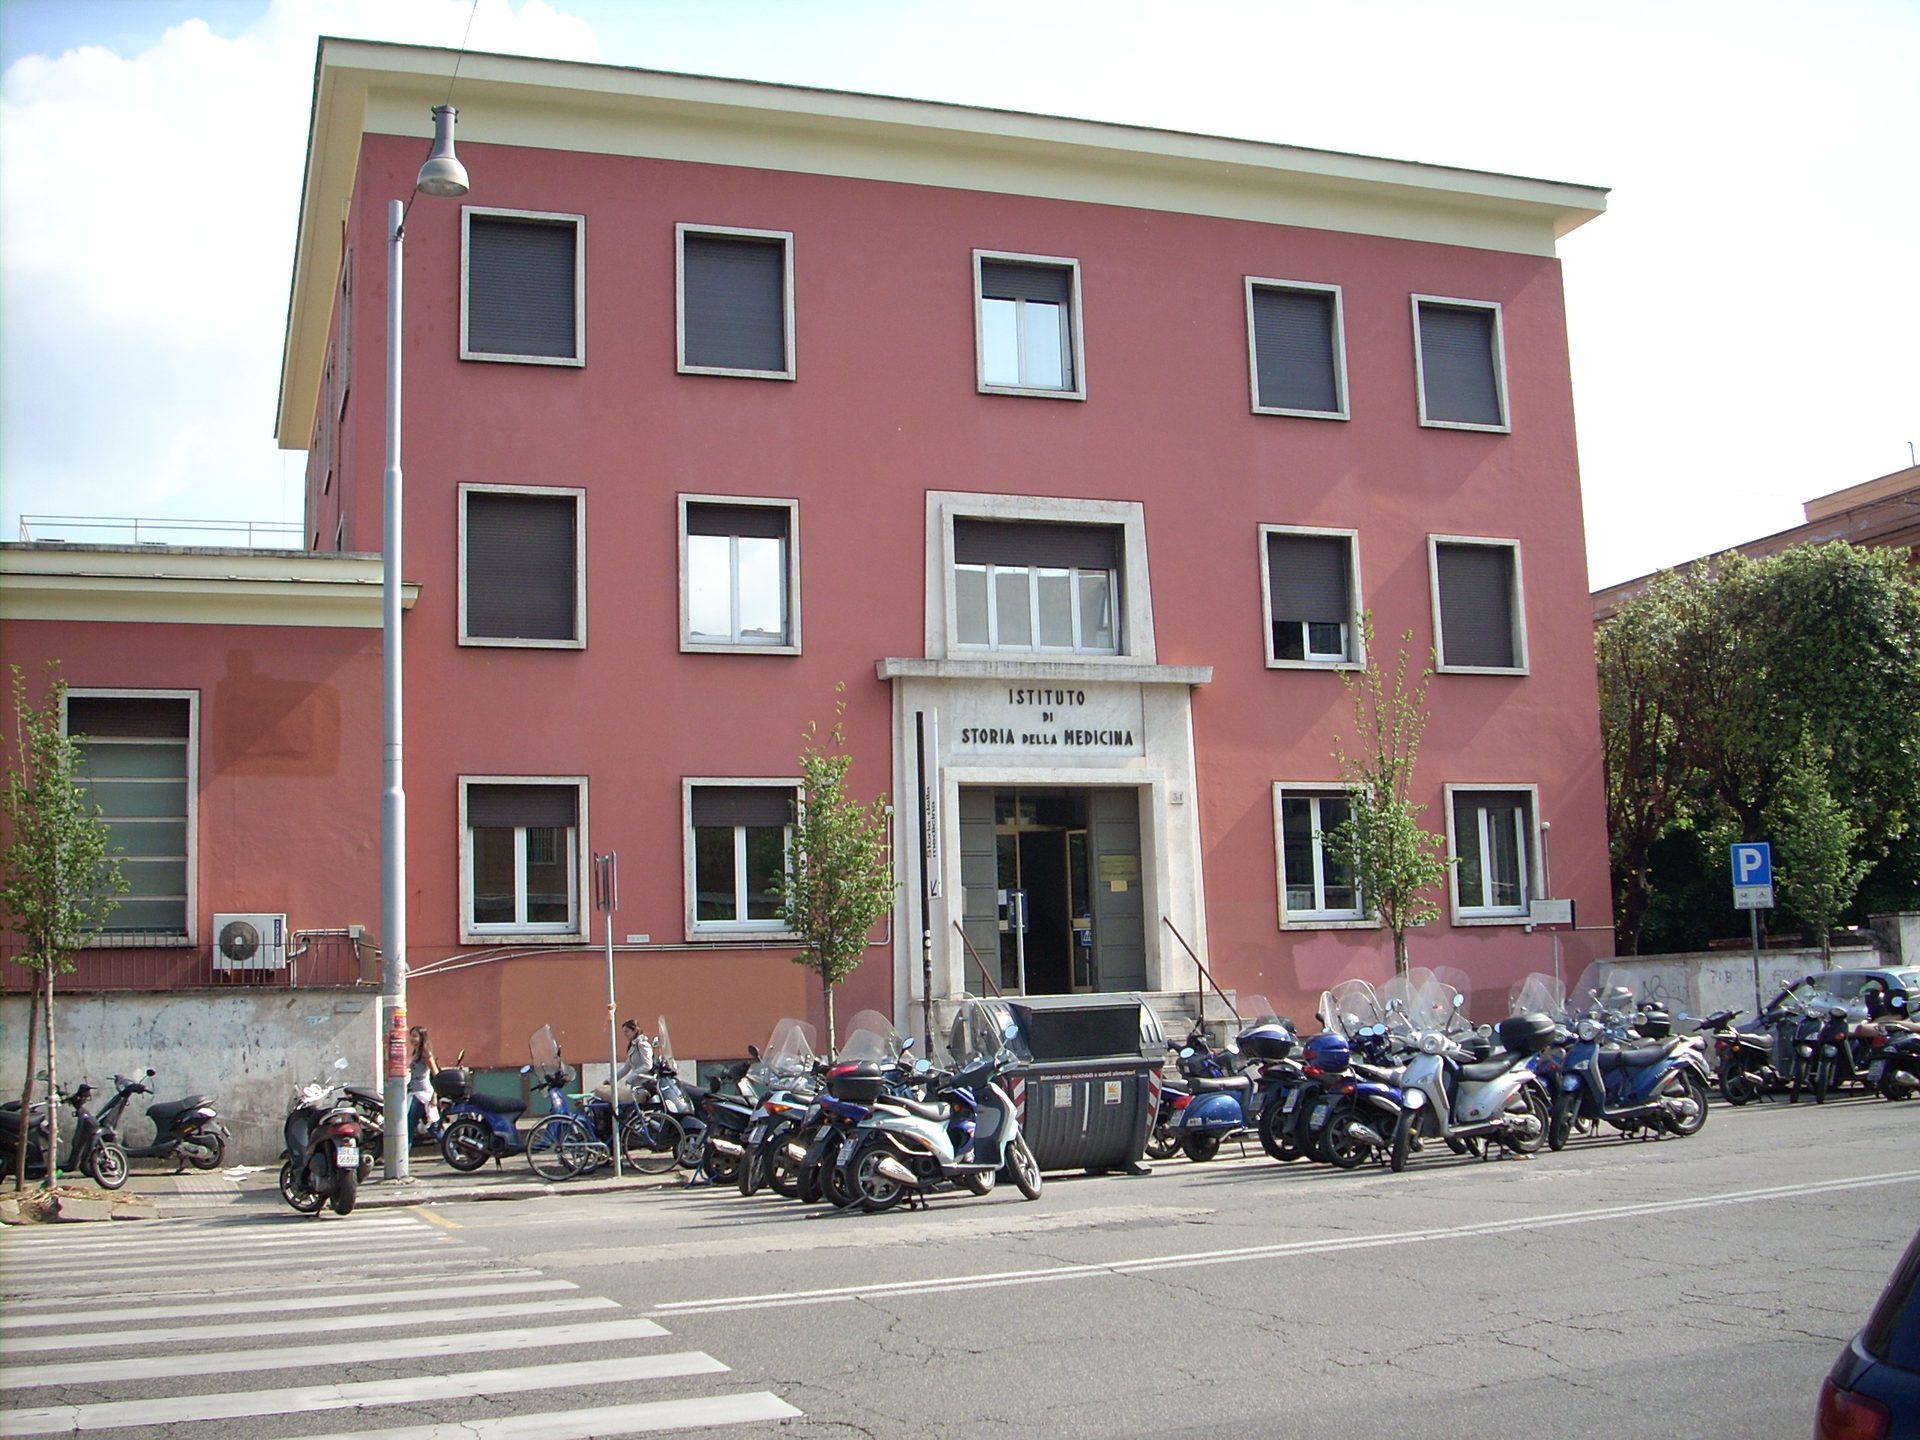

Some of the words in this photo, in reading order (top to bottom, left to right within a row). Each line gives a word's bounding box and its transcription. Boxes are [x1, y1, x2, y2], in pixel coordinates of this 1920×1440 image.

[1009, 688, 1085, 706] ISTITUTO
[1042, 711, 1054, 723] DI
[961, 728, 1015, 745] STORIA
[1022, 733, 1058, 745] DELLA
[1064, 729, 1134, 747] MEDICINA
[1738, 848, 1762, 882] P
